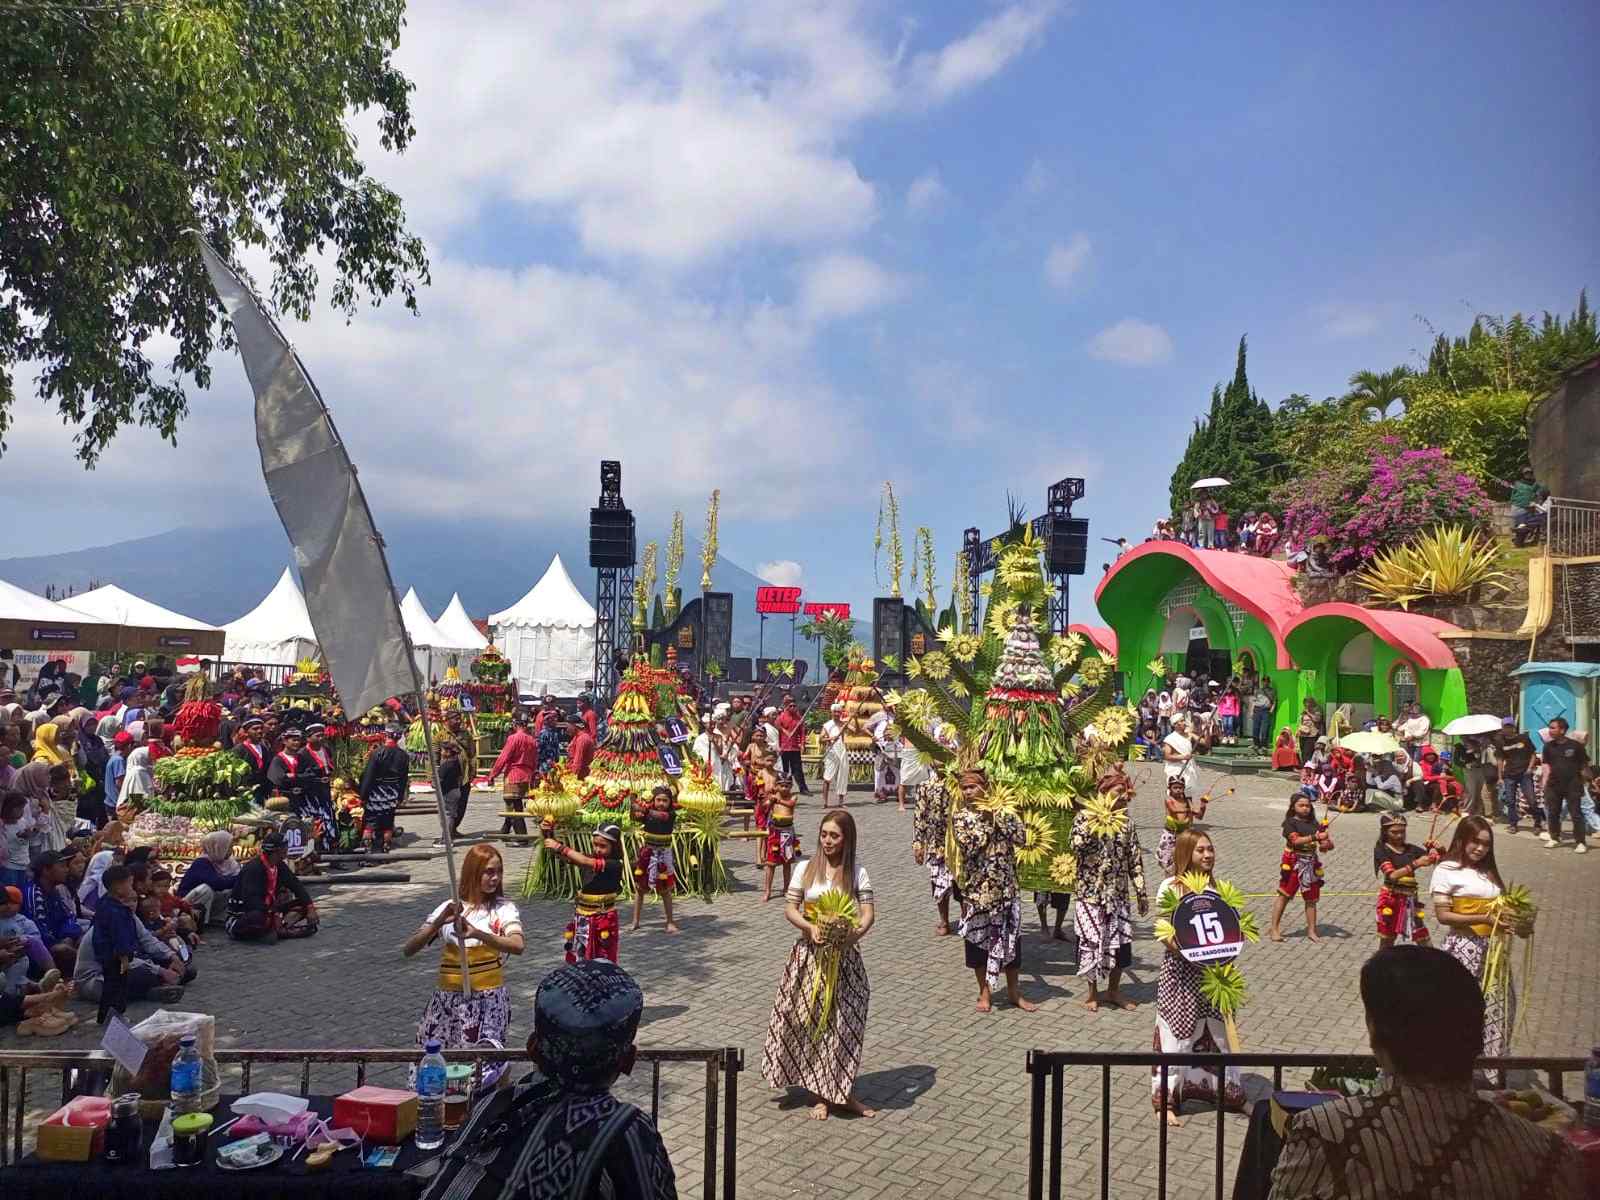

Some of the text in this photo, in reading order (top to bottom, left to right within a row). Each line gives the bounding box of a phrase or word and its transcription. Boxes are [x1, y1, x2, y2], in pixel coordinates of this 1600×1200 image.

[757, 588, 801, 602] KETEP
[757, 602, 801, 613] SUMMIT
[671, 723, 682, 737] 11
[1189, 912, 1225, 946] 15
